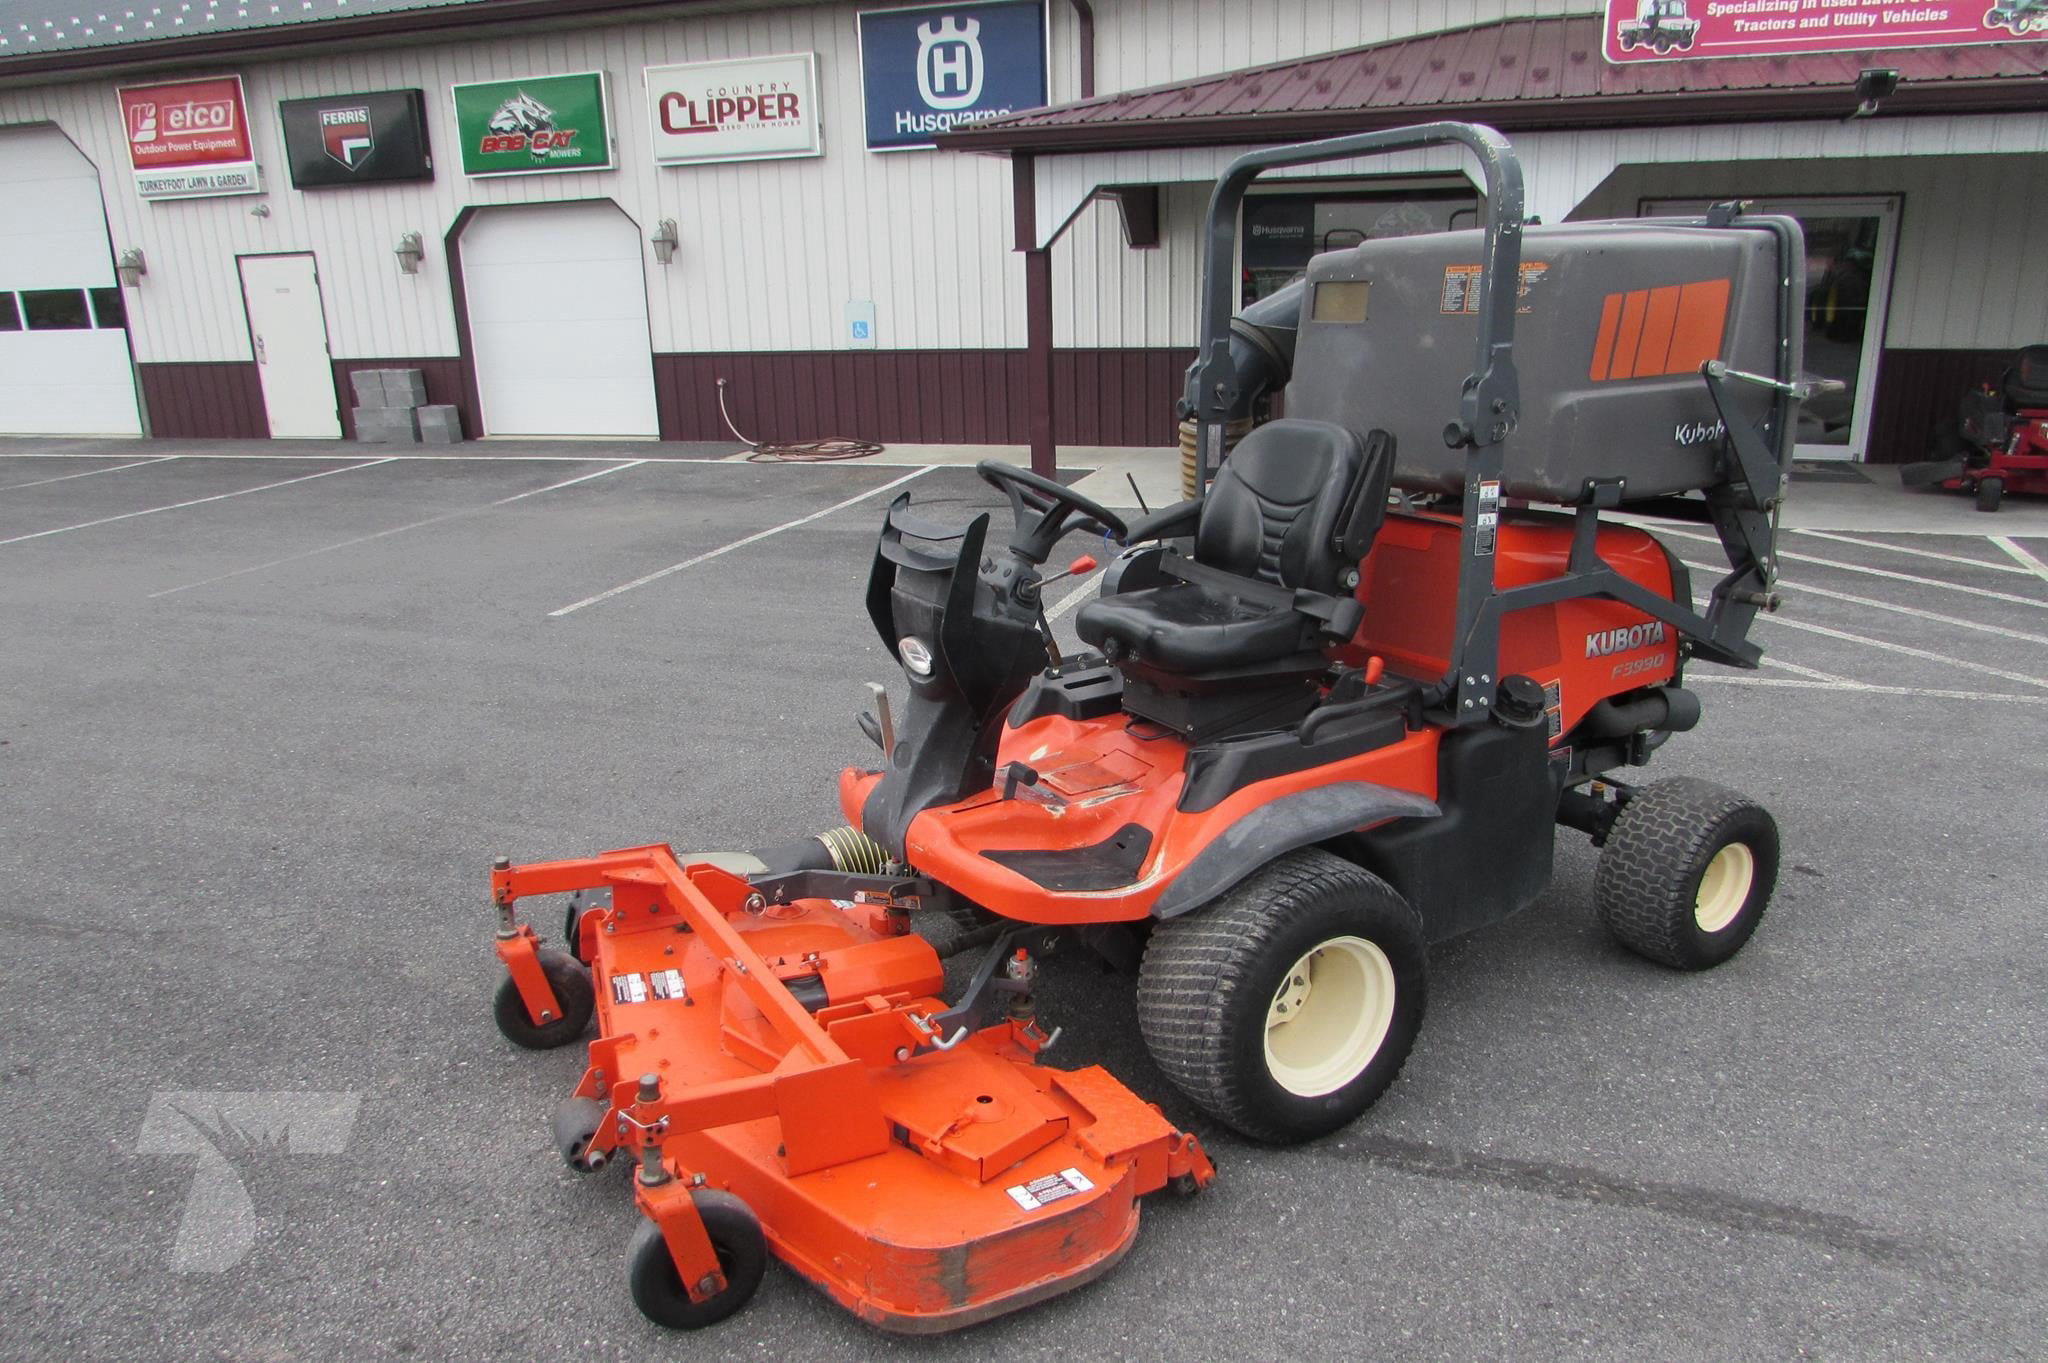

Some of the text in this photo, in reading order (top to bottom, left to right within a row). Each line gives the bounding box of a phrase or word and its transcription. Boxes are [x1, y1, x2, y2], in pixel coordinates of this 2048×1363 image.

[1707, 0, 1798, 17] Specializing
[1734, 9, 1948, 32] Tractors and Utility Vehicles
[706, 82, 790, 97] COUNTRY
[169, 101, 225, 129] efco
[323, 110, 367, 126] FERRIS
[659, 91, 800, 135] CLIPPER
[135, 138, 237, 155] Outdoor Power Equipment
[549, 148, 581, 158] MOWERS
[139, 174, 247, 192] TURKEYFOOT LAWN & GARDEN
[1585, 620, 1665, 658] KUBOTA
